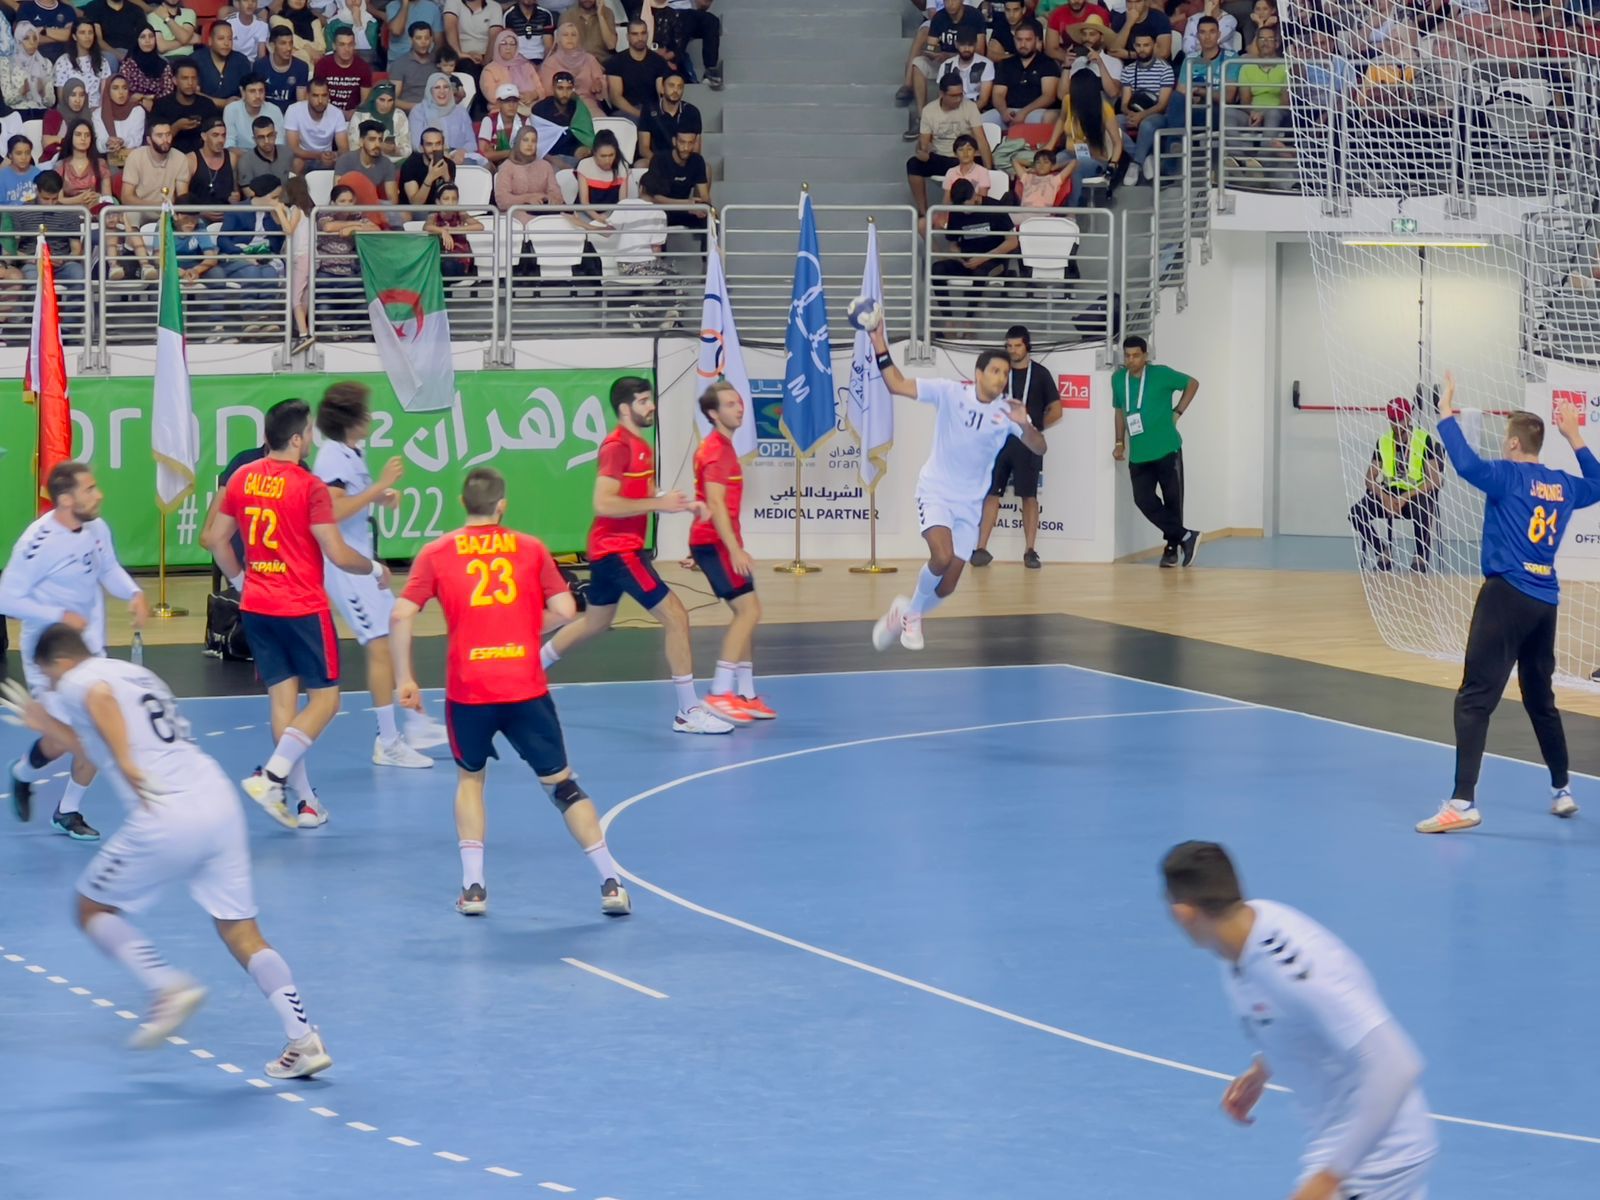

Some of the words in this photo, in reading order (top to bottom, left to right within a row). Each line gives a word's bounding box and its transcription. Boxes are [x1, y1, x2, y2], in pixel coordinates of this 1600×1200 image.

[965, 410, 984, 431] 31
[244, 507, 279, 550] 72
[754, 508, 814, 520] MEDICAL
[466, 557, 517, 607] 23
